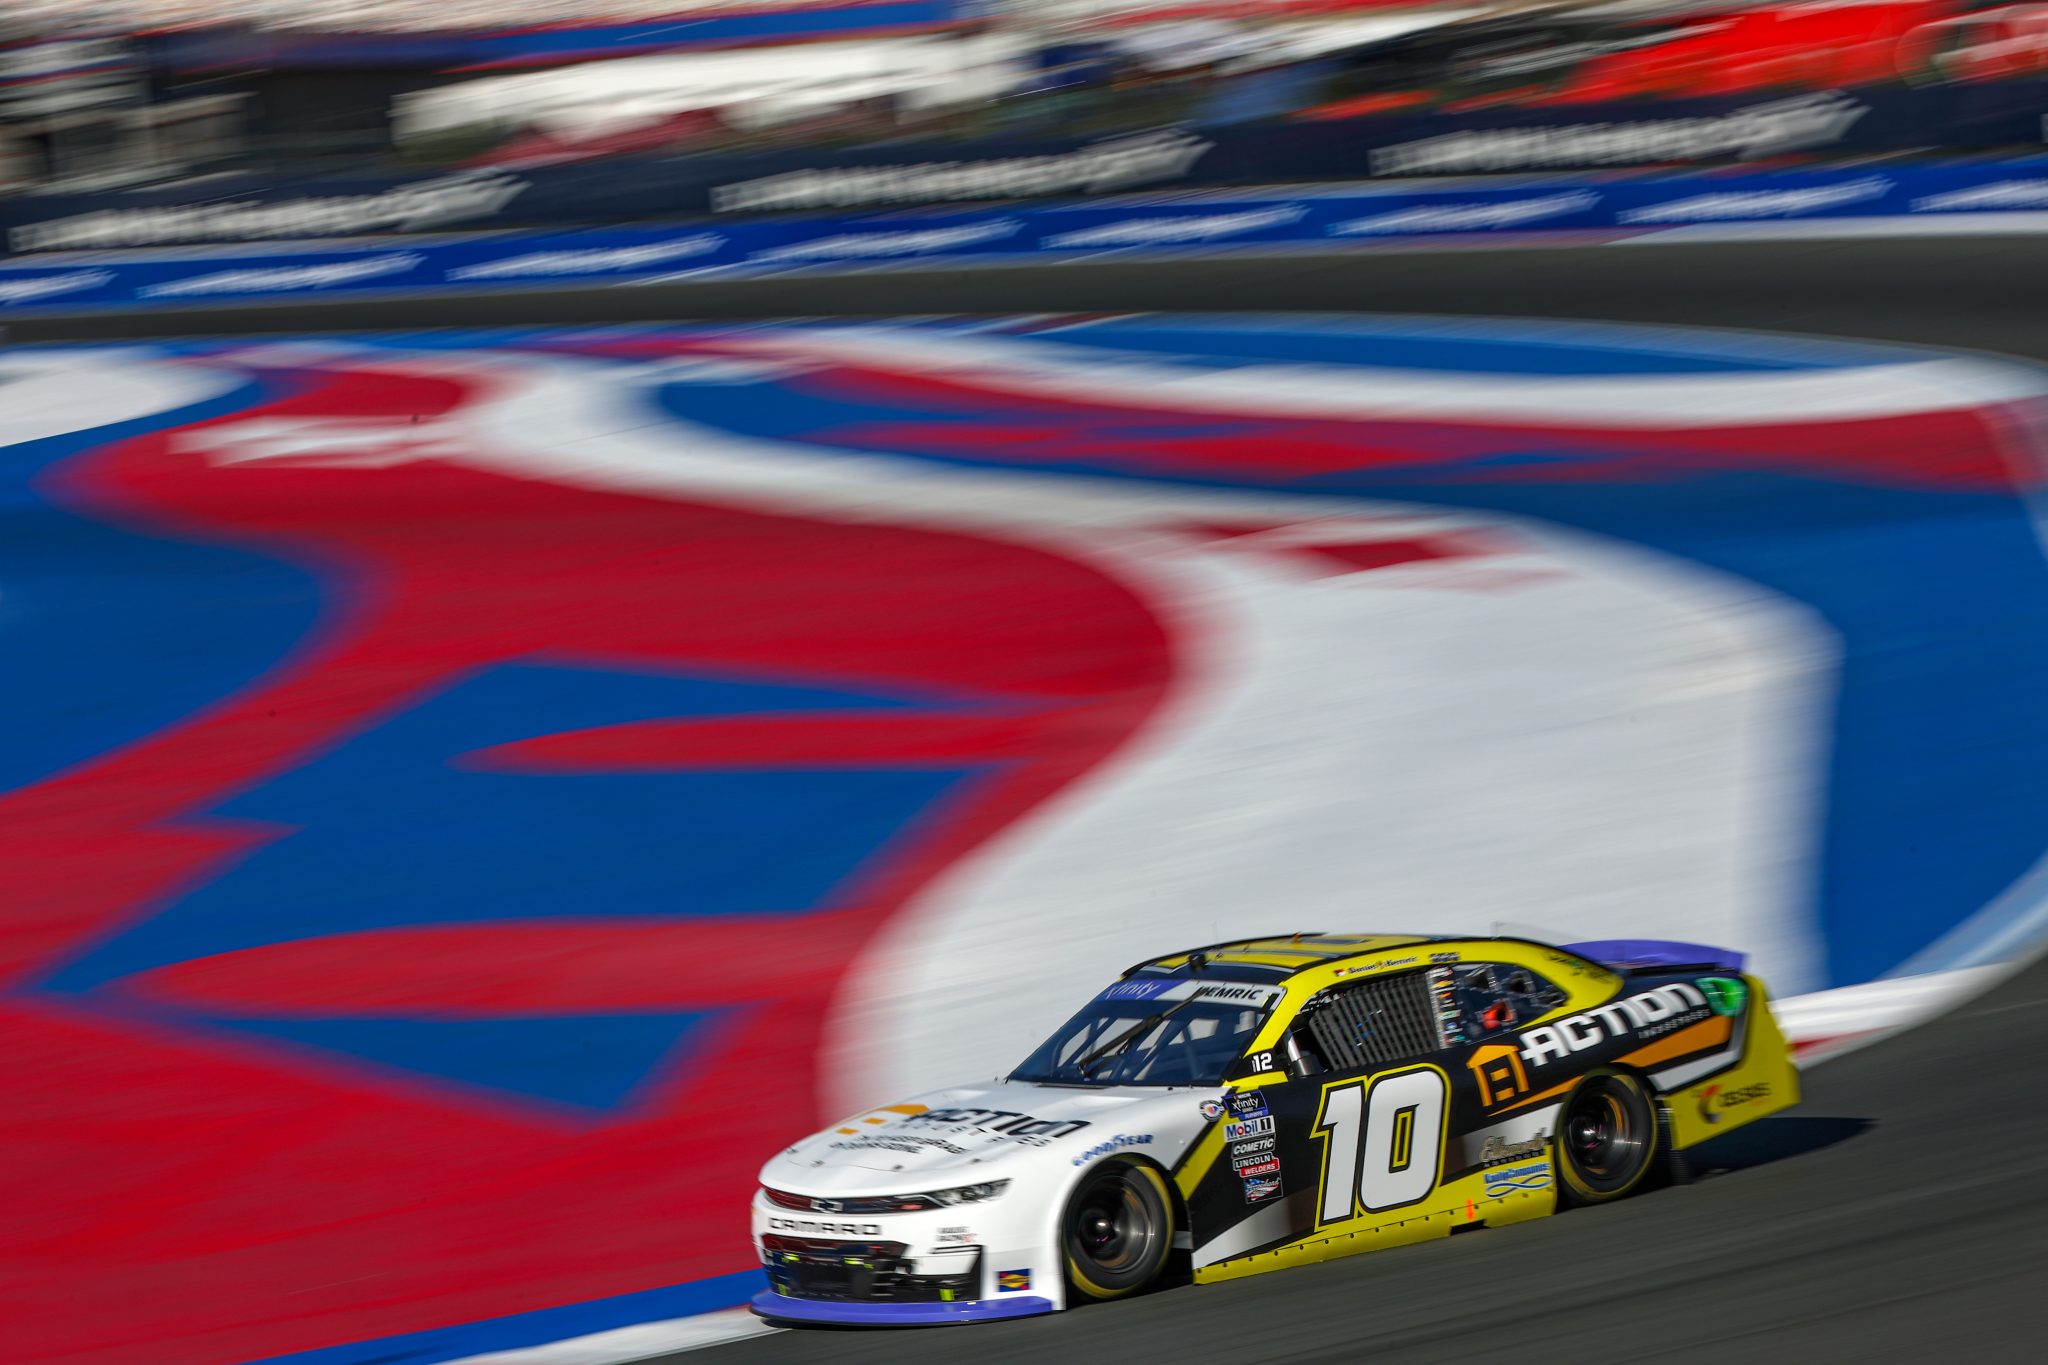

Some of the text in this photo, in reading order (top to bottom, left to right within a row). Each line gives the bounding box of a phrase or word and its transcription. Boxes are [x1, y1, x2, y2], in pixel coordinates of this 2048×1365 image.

[1519, 982, 1707, 1067] ACTION
[1231, 1097, 1259, 1112] xfinity
[1226, 1120, 1258, 1138] Mobil
[1261, 1118, 1270, 1130] 1
[1071, 1134, 1153, 1166] GOODYEAR
[1233, 1138, 1274, 1155] COMETIC
[1316, 1066, 1448, 1226] 10
[1235, 1154, 1271, 1169] LINCOLN
[1244, 1163, 1276, 1175] WELDERS
[768, 1217, 882, 1236] CAMARO
